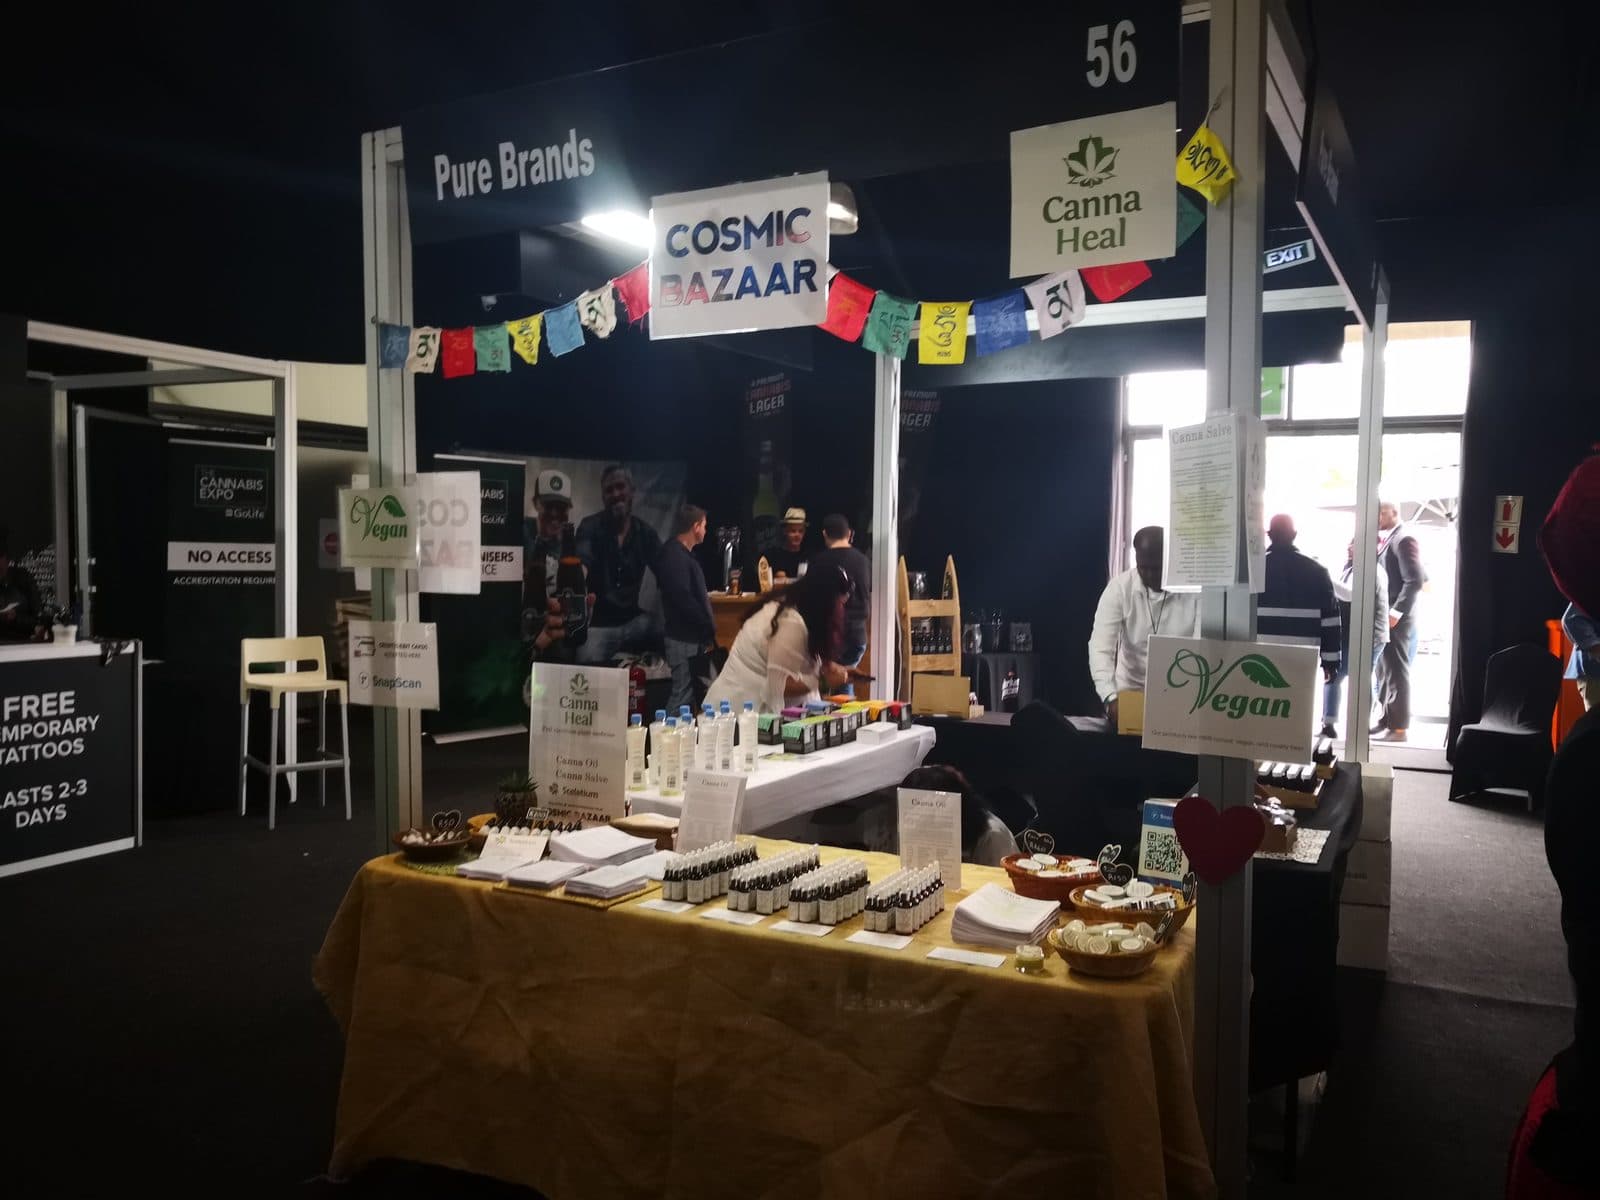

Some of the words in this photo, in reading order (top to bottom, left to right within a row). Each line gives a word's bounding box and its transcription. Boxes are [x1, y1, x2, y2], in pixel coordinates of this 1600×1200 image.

[1086, 19, 1137, 88] 56
[434, 153, 493, 201] Pure
[498, 127, 596, 190] Brands
[1043, 190, 1142, 224] Canna
[665, 207, 811, 258] COSMIC
[1057, 217, 1126, 255] Heal
[1266, 245, 1304, 267] EXIT
[659, 258, 818, 308] BAZAAR
[750, 394, 785, 415] LAGER
[1172, 432, 1203, 445] Canna
[199, 488, 234, 501] EXPO
[200, 476, 264, 491] CANNABIS
[351, 494, 408, 542] Vegan
[188, 550, 213, 563] NO
[216, 551, 272, 564] ACCESS
[173, 576, 241, 585] ACCREDITATION
[373, 676, 422, 690] SnapScan
[1167, 649, 1291, 719] Vegan
[3, 690, 76, 721] FREE
[559, 696, 598, 712] Canna
[0, 714, 100, 743] MPORARY
[564, 712, 593, 727] Heal
[0, 784, 54, 809] ASTS
[58, 779, 88, 799] 2-3
[16, 803, 67, 829] DAYS
